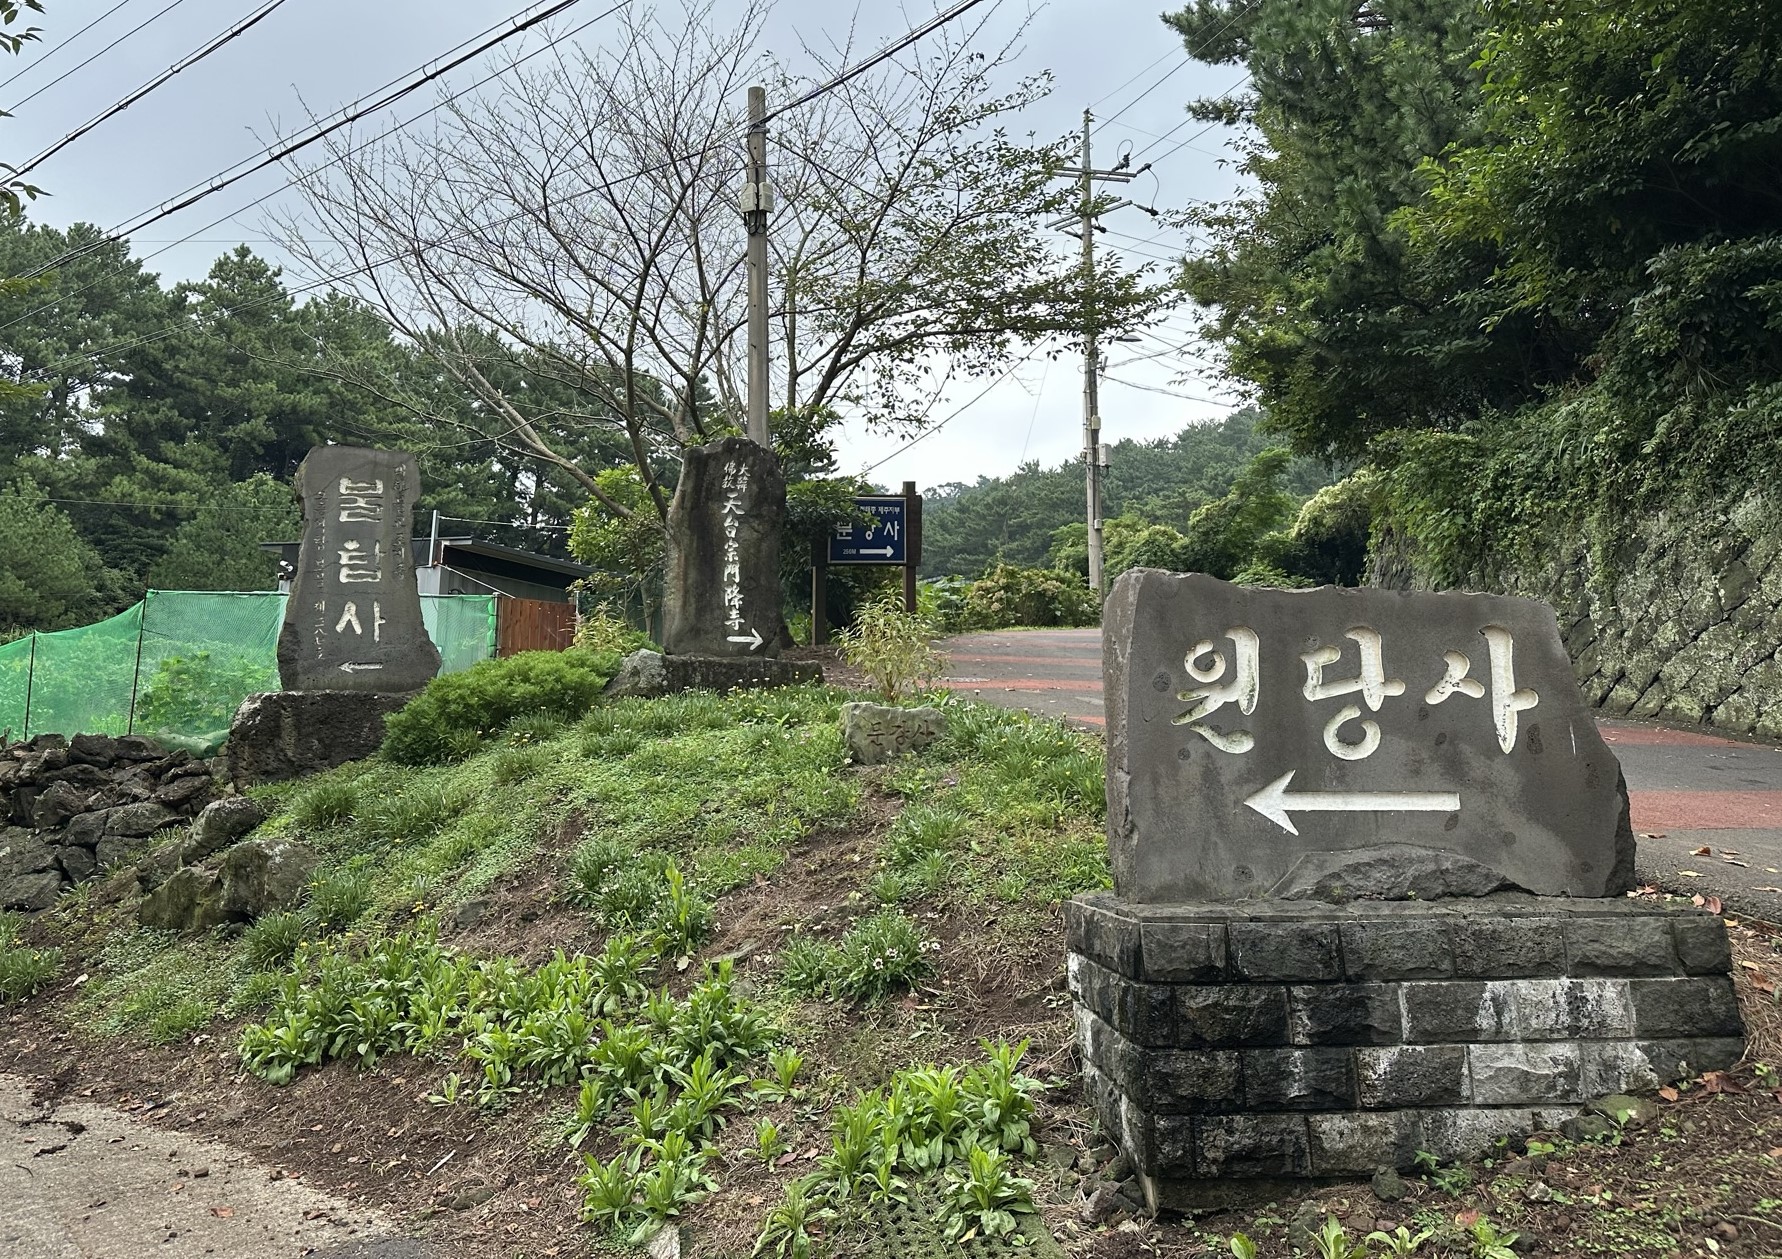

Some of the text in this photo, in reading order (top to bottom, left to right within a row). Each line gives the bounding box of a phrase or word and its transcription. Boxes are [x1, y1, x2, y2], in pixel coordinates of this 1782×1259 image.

[335, 477, 387, 643] 불탑사
[867, 720, 936, 746] 문강사
[1170, 624, 1540, 761] 원당사
